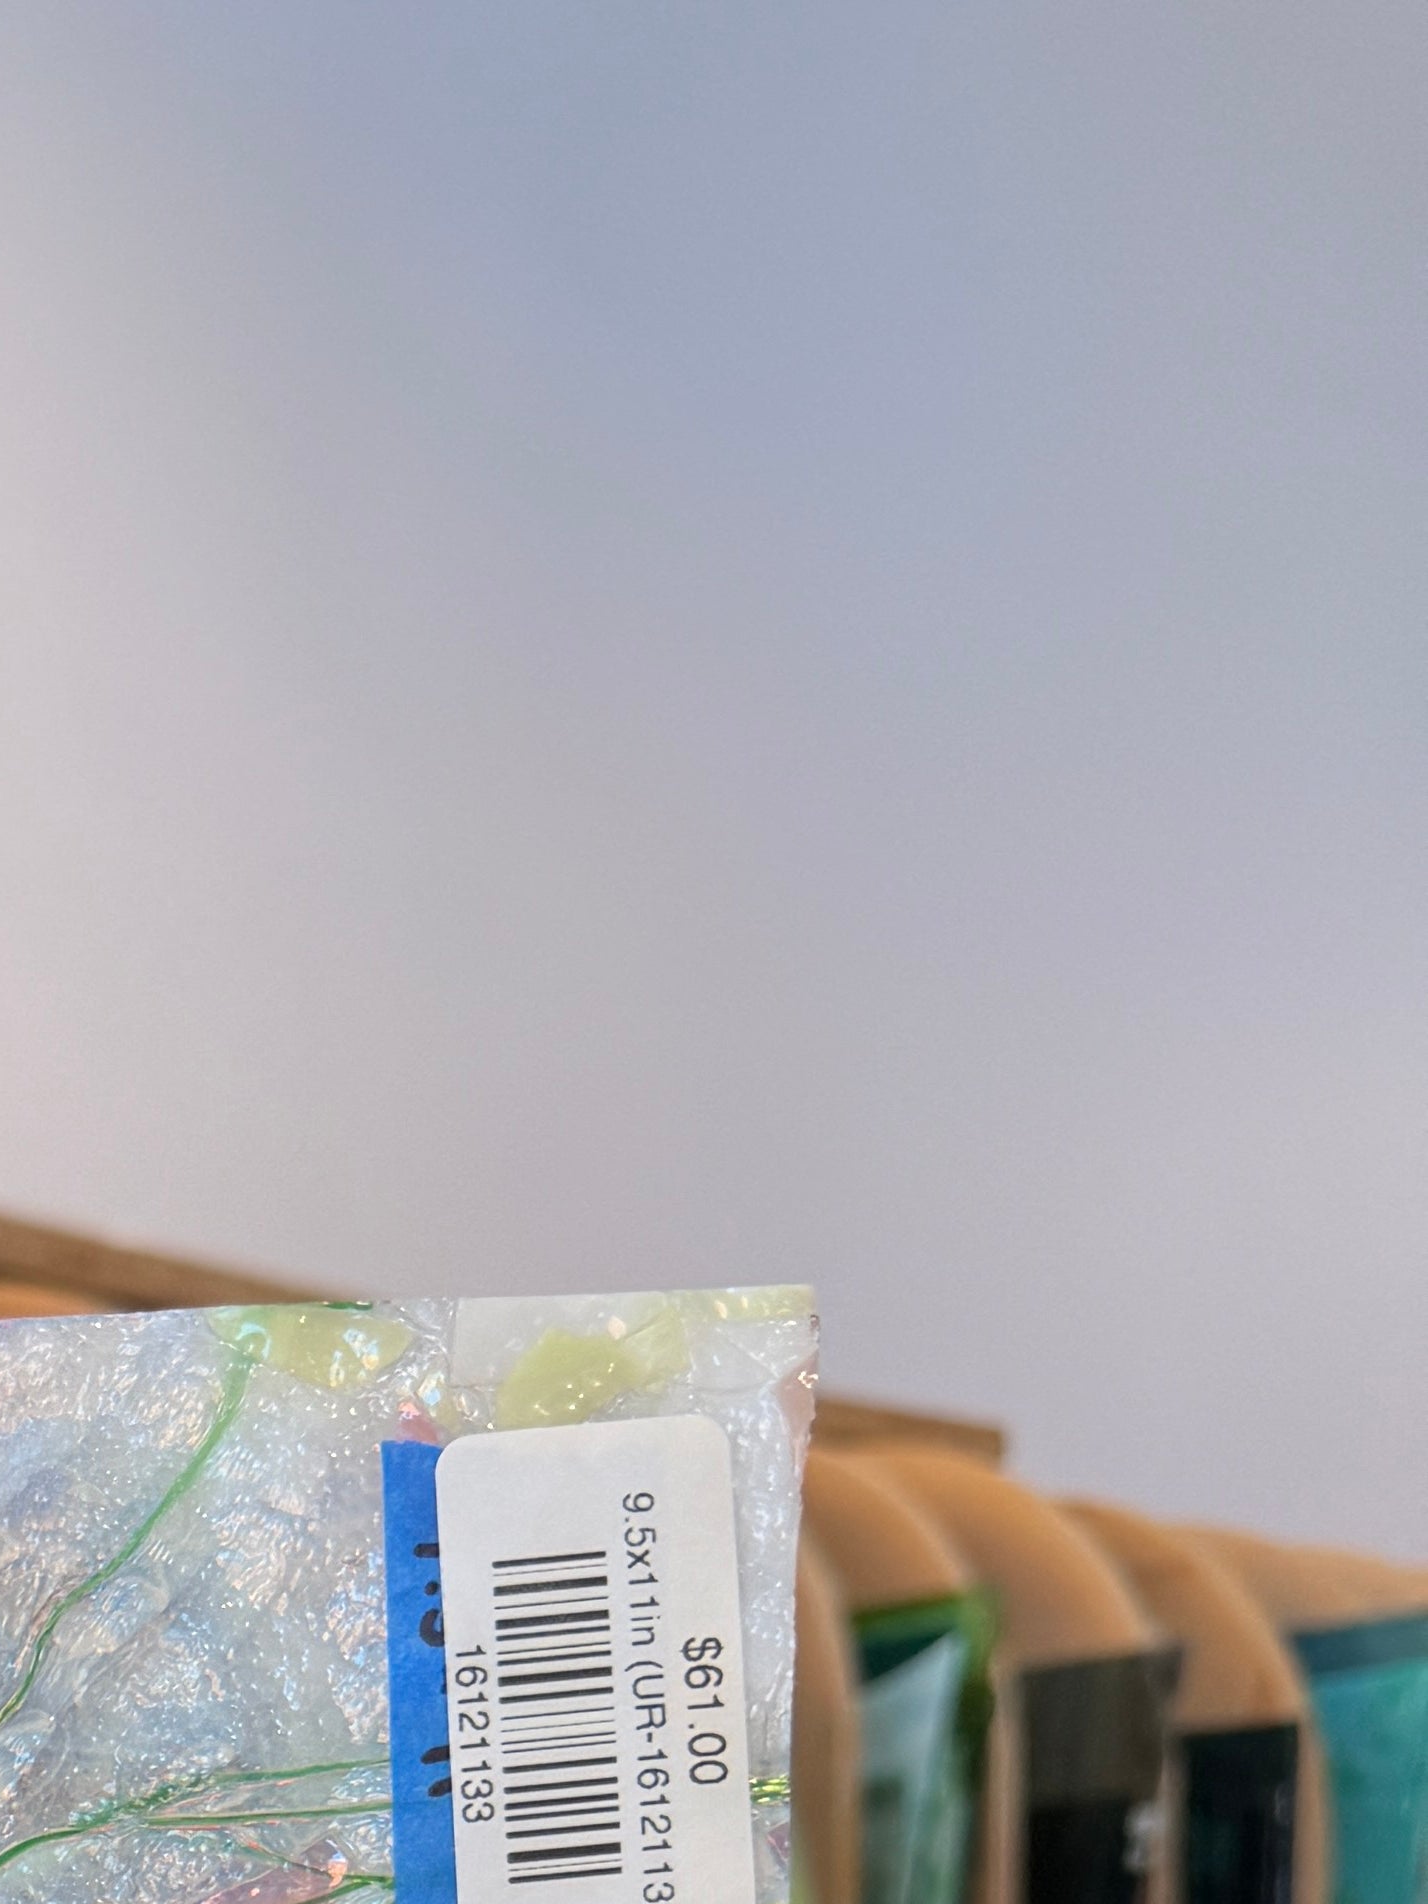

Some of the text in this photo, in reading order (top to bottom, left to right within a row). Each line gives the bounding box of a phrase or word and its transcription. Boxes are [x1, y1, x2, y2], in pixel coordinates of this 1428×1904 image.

[622, 1491, 660, 1647] 9.5x11in
[454, 1643, 495, 1825] 16121133
[679, 1636, 729, 1786] $61.00
